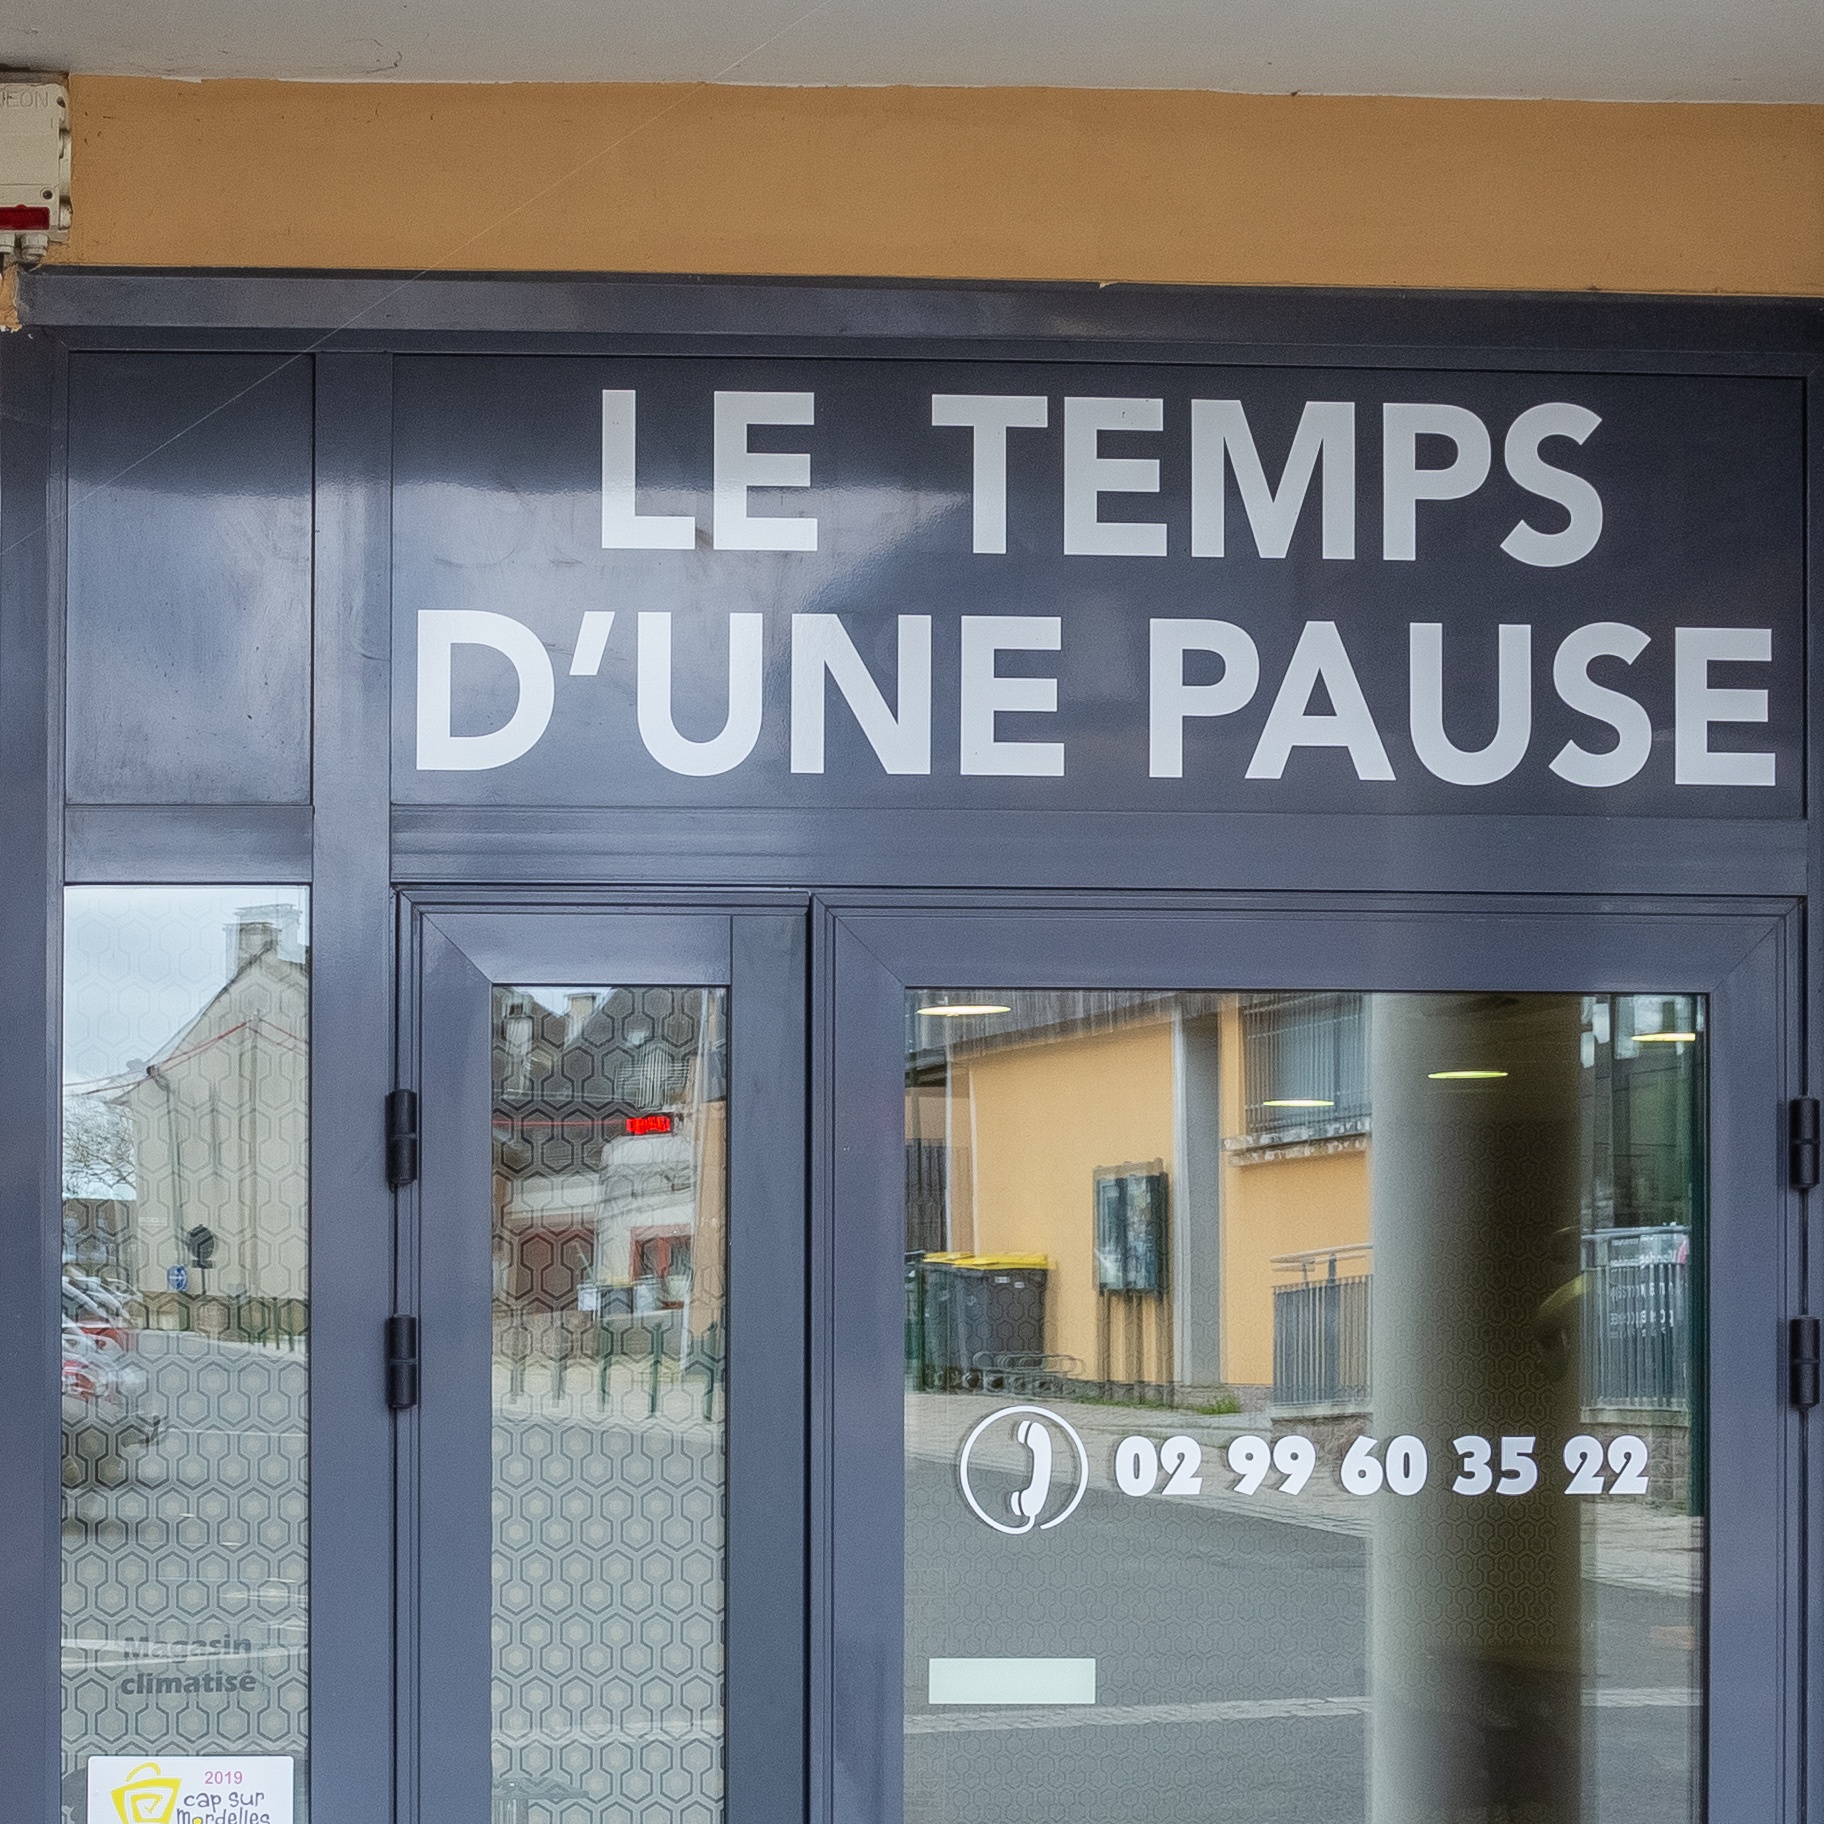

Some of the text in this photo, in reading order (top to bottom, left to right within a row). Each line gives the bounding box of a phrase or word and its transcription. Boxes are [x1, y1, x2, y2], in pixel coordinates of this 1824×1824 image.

[600, 388, 1605, 568] LE TEMPS
[1147, 617, 1778, 788] PAUSE
[1114, 1433, 1651, 1498] 02 99 60 35 22
[123, 1634, 252, 1663] Magasin
[120, 1670, 256, 1695] climatisé
[204, 1771, 243, 1785] 2019
[183, 1791, 265, 1813] cap sur
